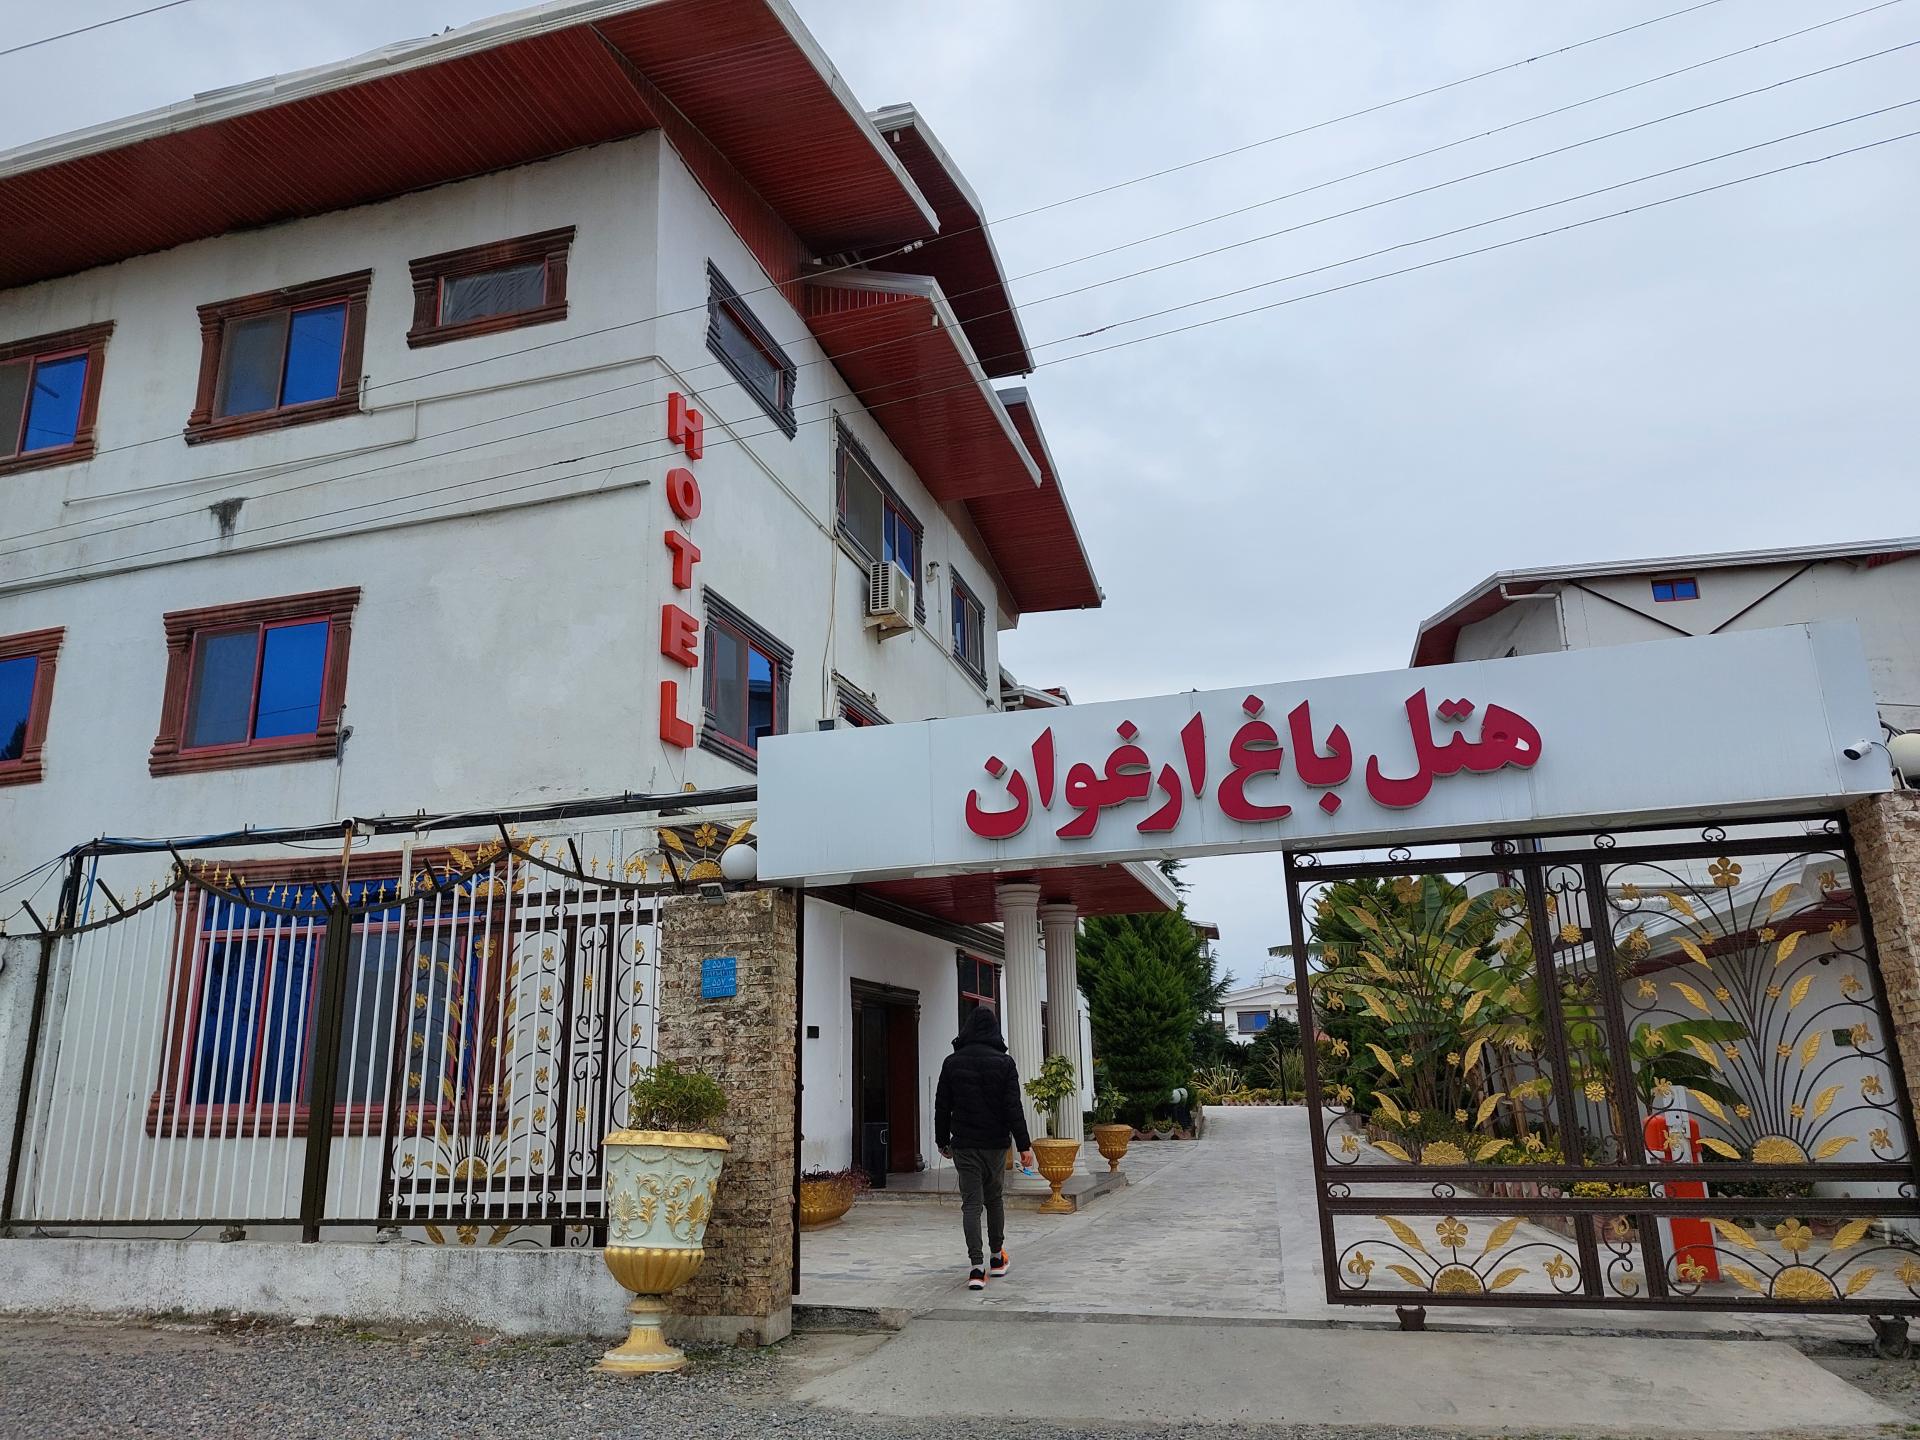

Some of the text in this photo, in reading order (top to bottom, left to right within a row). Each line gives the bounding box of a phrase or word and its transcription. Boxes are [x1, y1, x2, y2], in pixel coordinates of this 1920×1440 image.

[660, 391, 704, 749] HOTEL
[965, 687, 1543, 840] هتل باغ ارغوان
